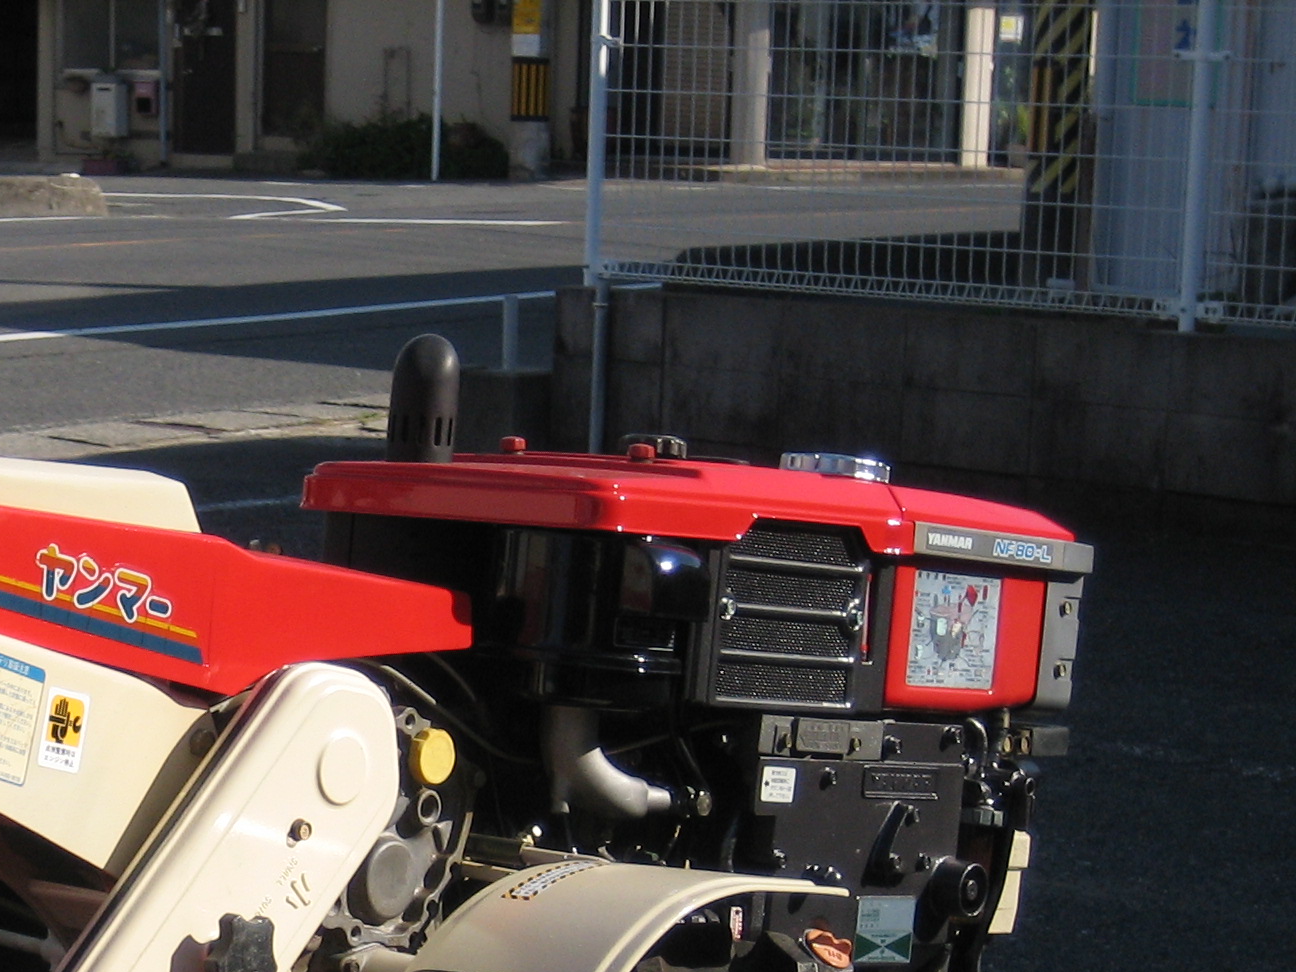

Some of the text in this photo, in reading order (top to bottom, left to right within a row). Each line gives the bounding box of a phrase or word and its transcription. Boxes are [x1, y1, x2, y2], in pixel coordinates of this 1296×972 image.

[928, 533, 973, 549] YANMAR
[36, 543, 172, 623] ヤンマー
[286, 873, 311, 909] 小
